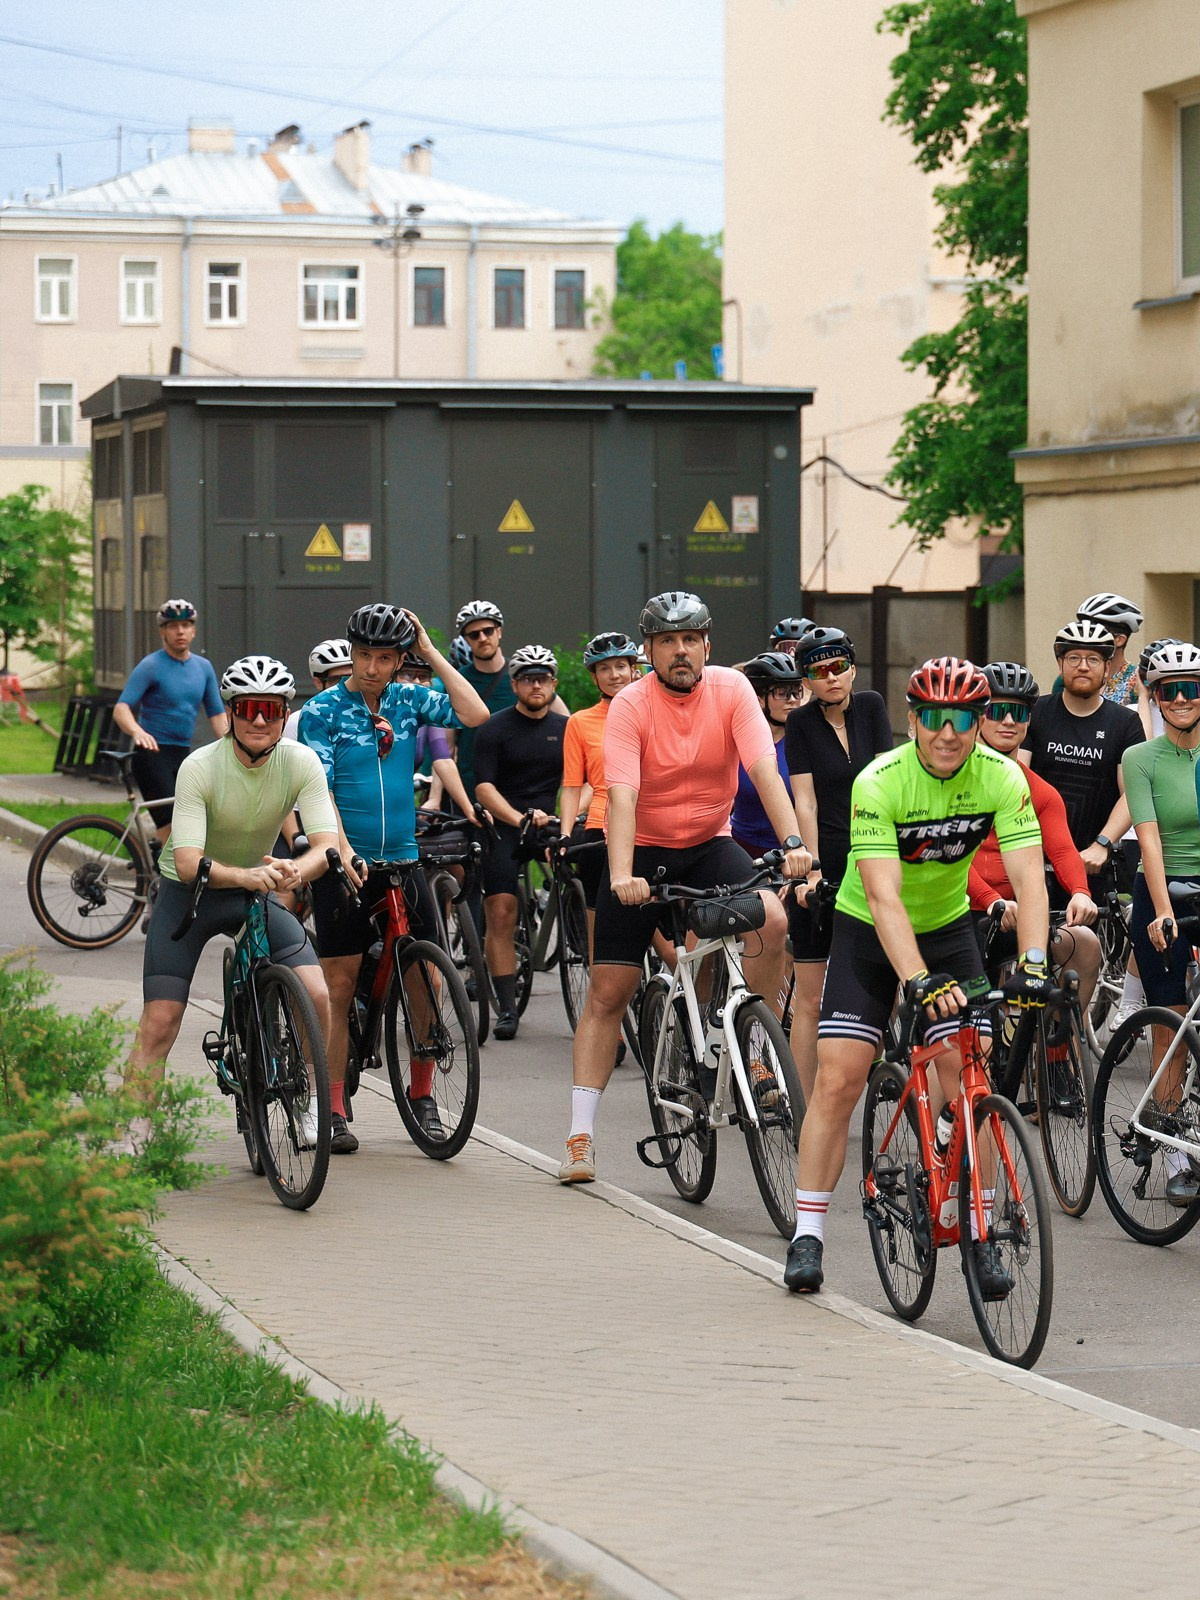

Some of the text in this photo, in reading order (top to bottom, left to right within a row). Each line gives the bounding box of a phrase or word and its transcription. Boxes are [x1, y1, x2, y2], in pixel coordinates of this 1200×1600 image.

[810, 649, 842, 662] ITALIA
[1047, 742, 1103, 760] PACMAN
[1054, 756, 1078, 765] RUNNING
[897, 817, 986, 839] TREK
[832, 1011, 862, 1021] Santini
